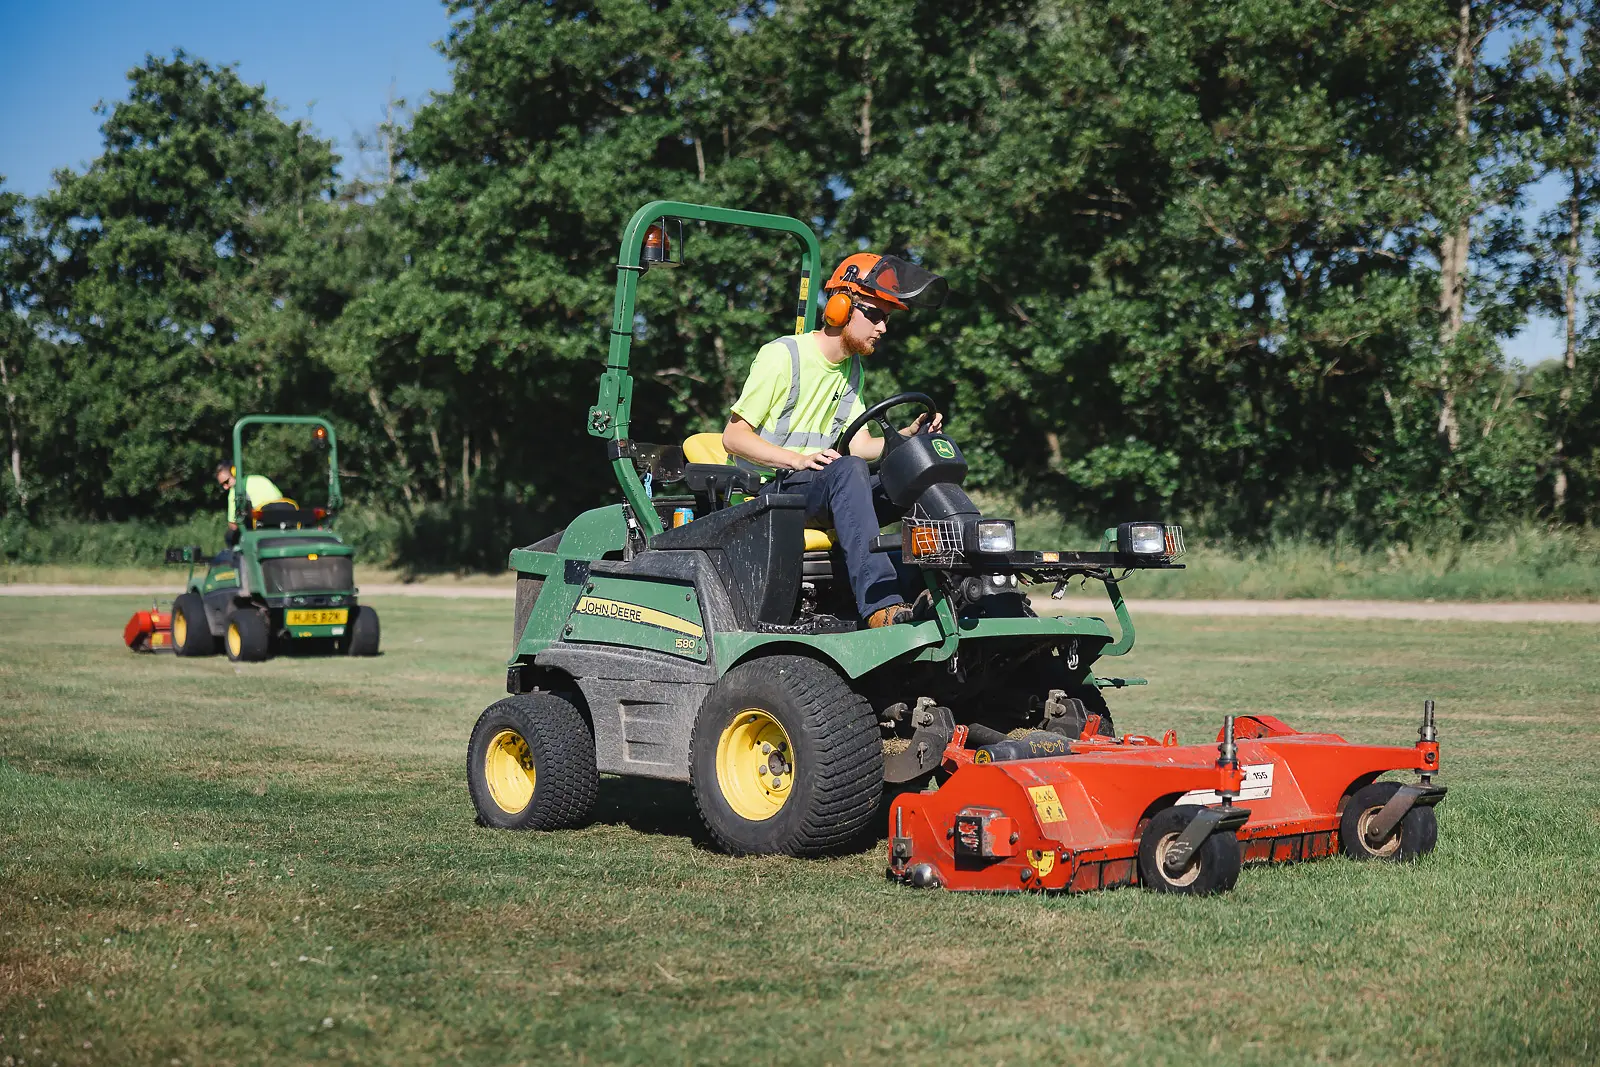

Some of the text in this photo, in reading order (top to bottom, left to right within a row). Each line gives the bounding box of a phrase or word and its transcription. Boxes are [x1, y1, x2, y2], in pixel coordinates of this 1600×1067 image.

[581, 600, 642, 621] JOHN DEERE
[675, 638, 696, 649] 1580
[1252, 771, 1268, 780] 155
